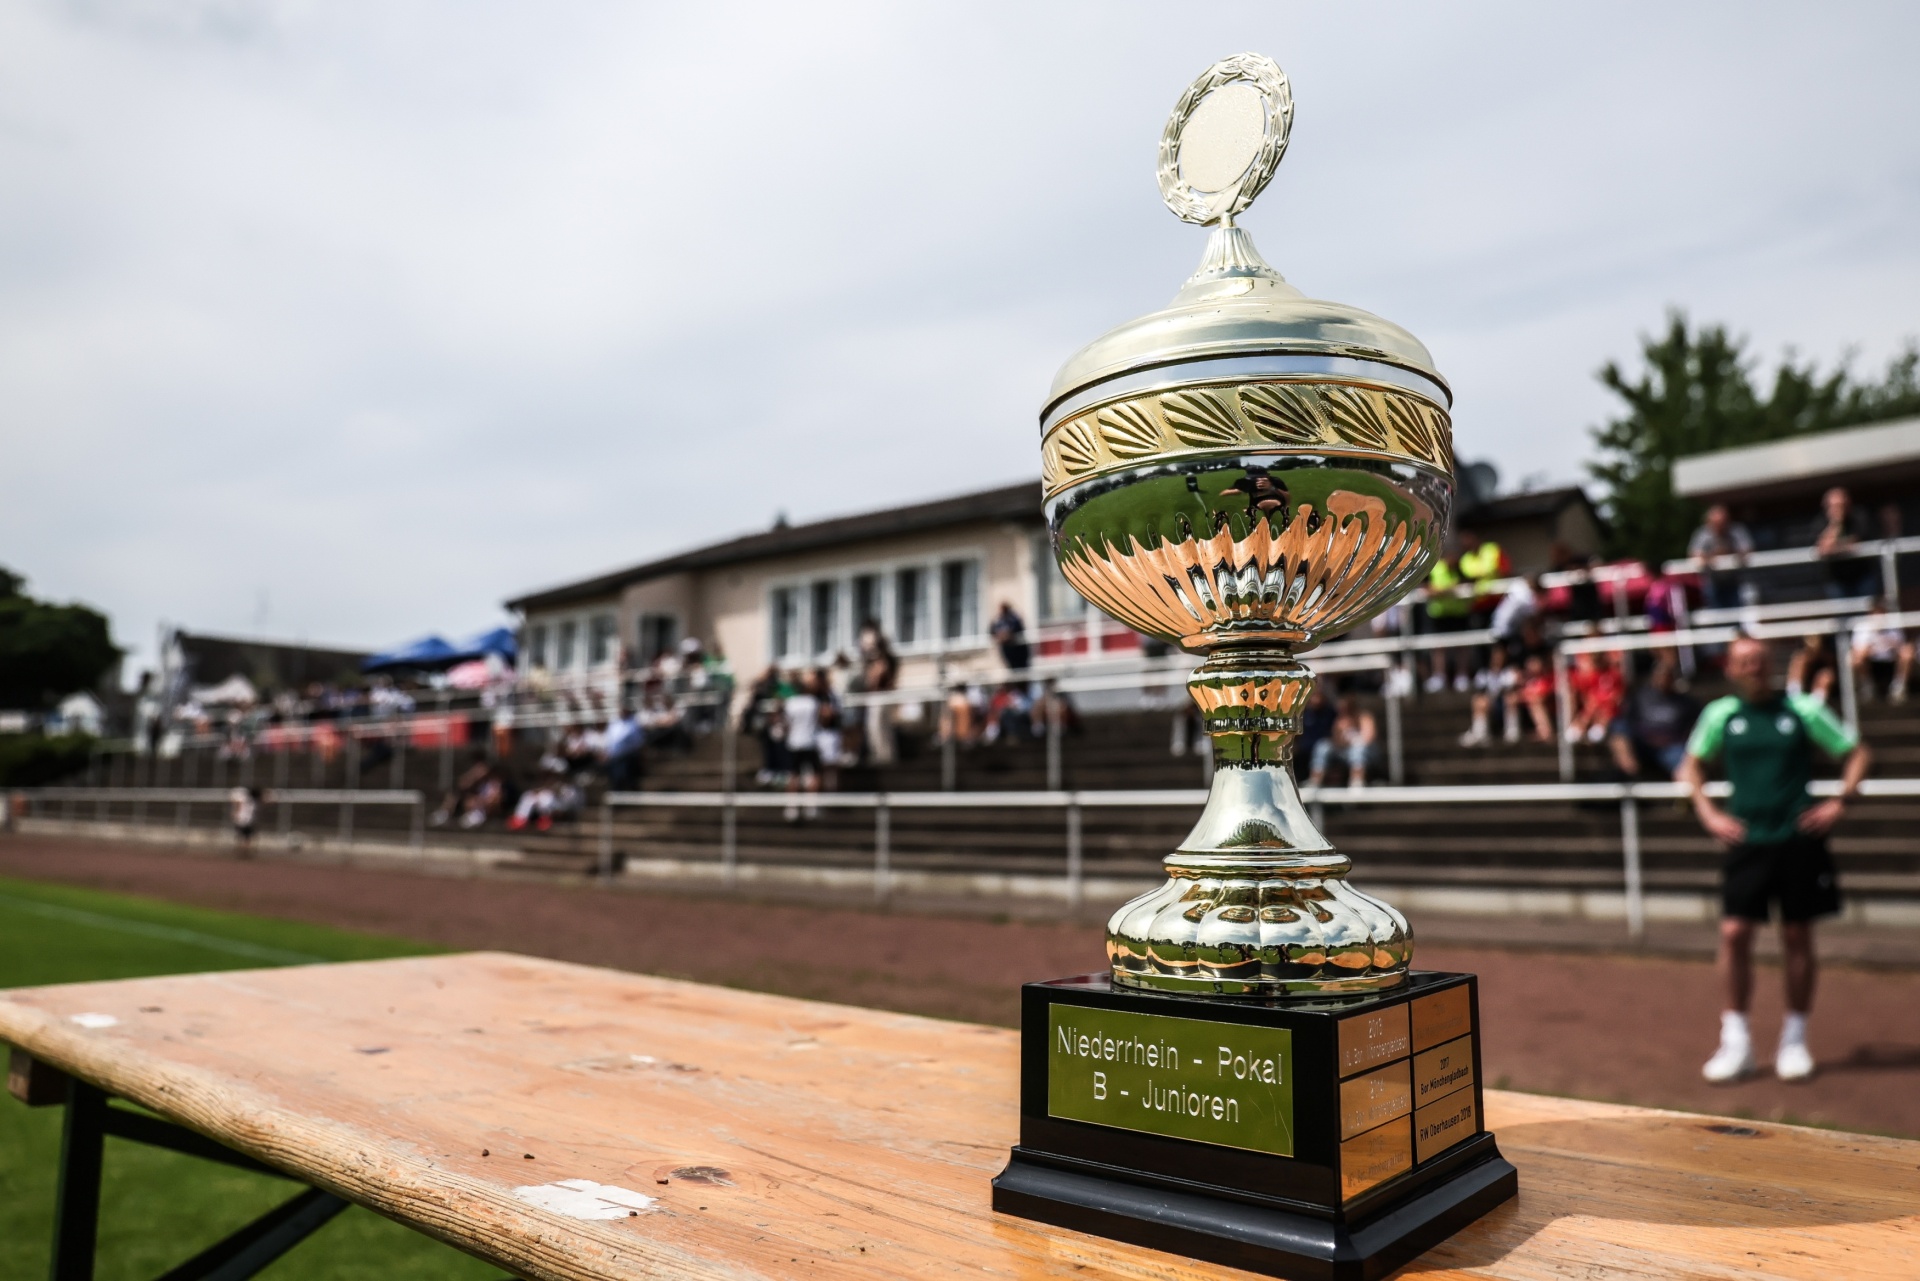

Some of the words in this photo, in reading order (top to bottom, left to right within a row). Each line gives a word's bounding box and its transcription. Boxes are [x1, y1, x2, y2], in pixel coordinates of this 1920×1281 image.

[1058, 1025, 1178, 1070] Niederrhein
[1218, 1046, 1283, 1085] Pokal
[1093, 1071, 1107, 1100] B
[1142, 1080, 1239, 1123] Junioren
[1430, 1114, 1460, 1136] Oberhausen
